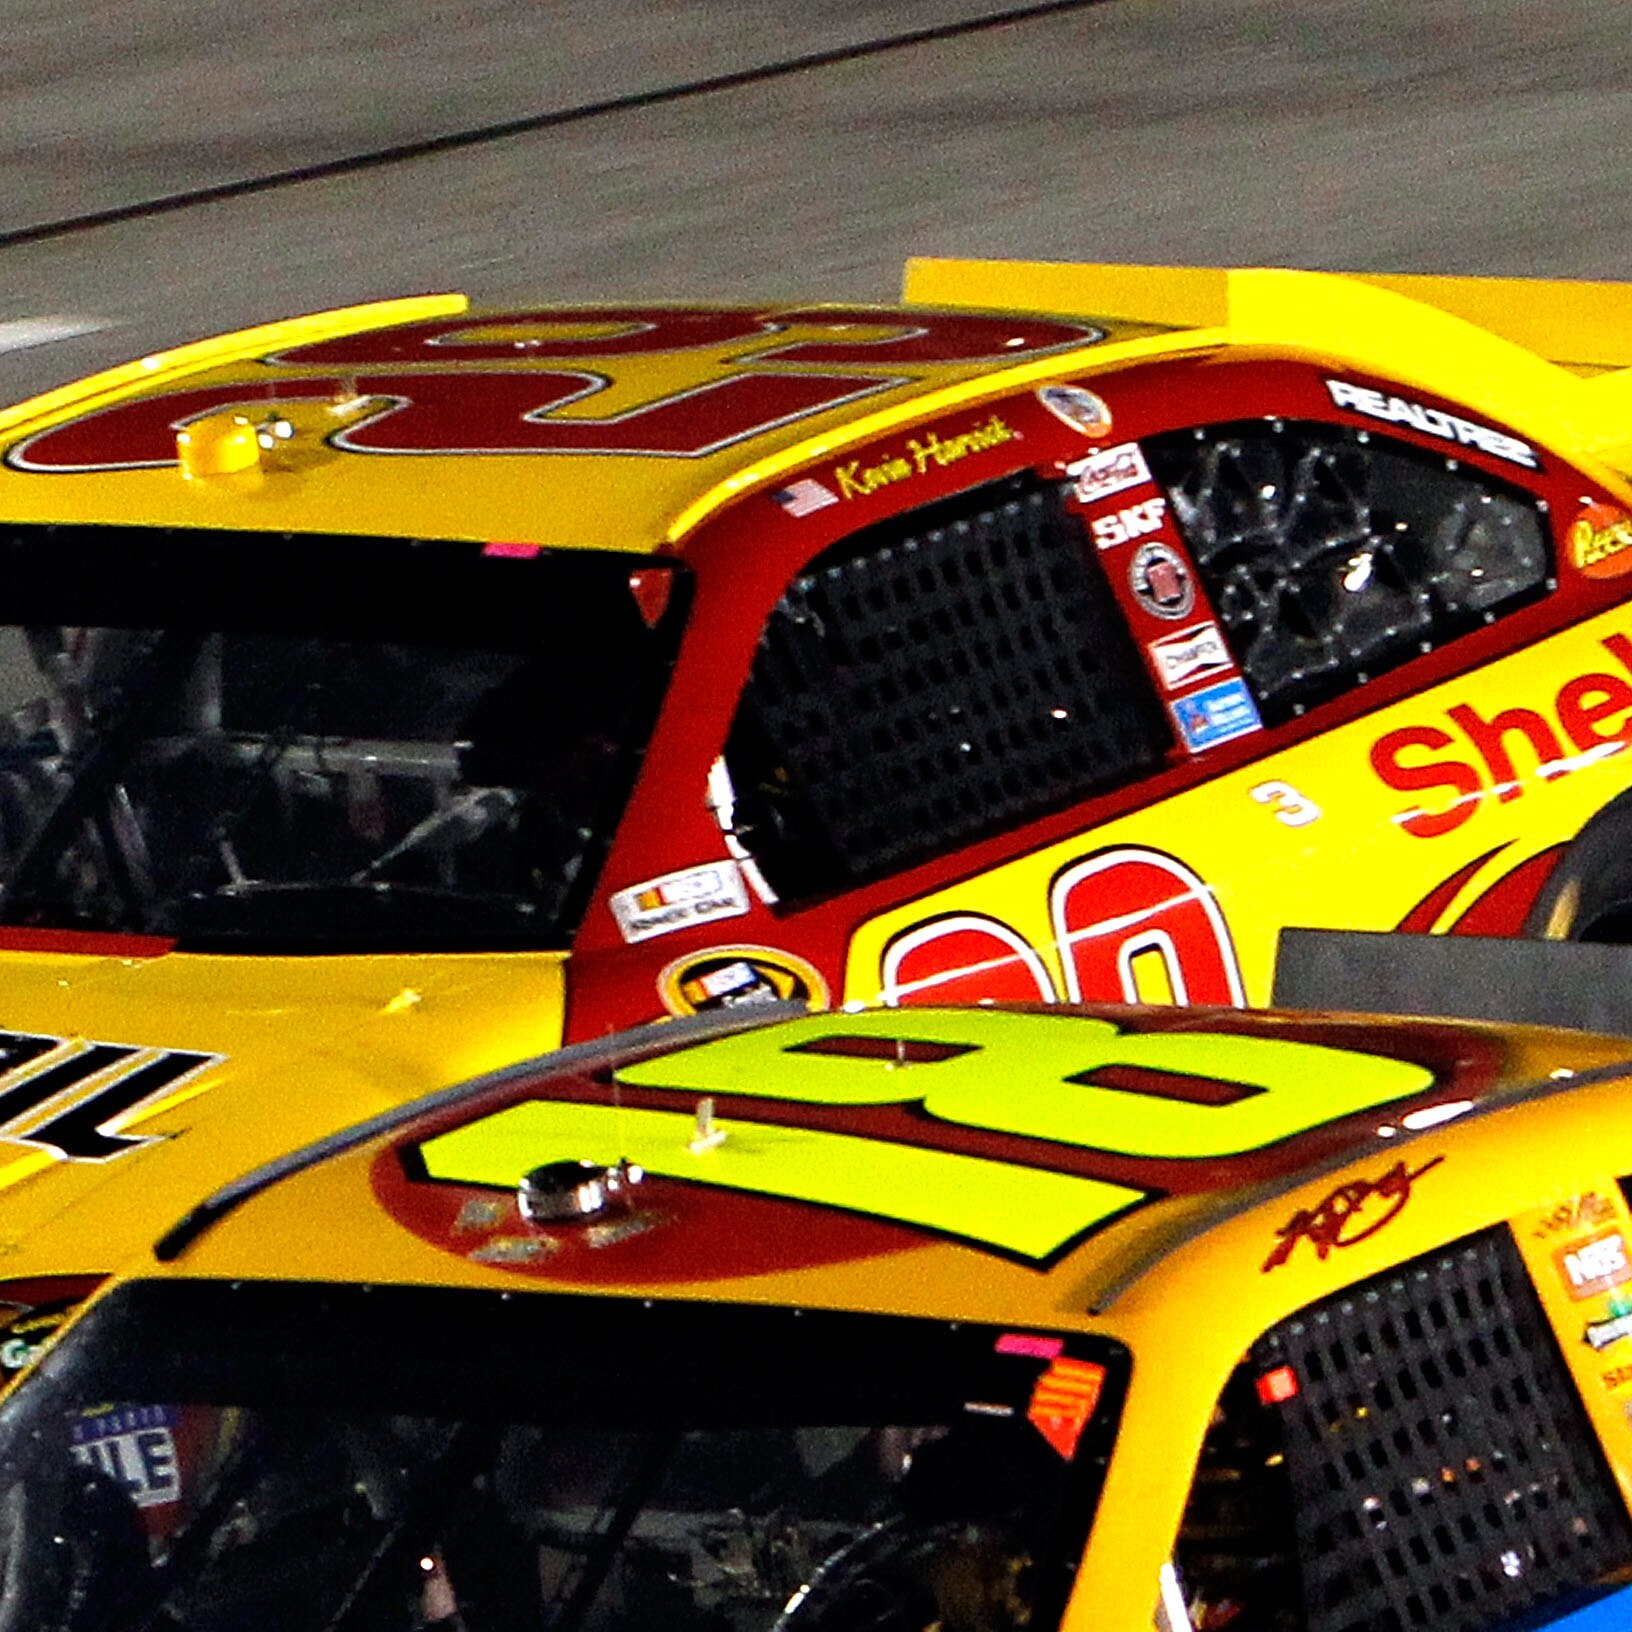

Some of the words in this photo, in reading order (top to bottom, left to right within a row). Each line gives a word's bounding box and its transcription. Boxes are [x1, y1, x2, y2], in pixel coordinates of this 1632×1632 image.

[1325, 379, 1540, 468] REALTREE
[1092, 498, 1166, 549] SKF
[1250, 779, 1321, 827] 3
